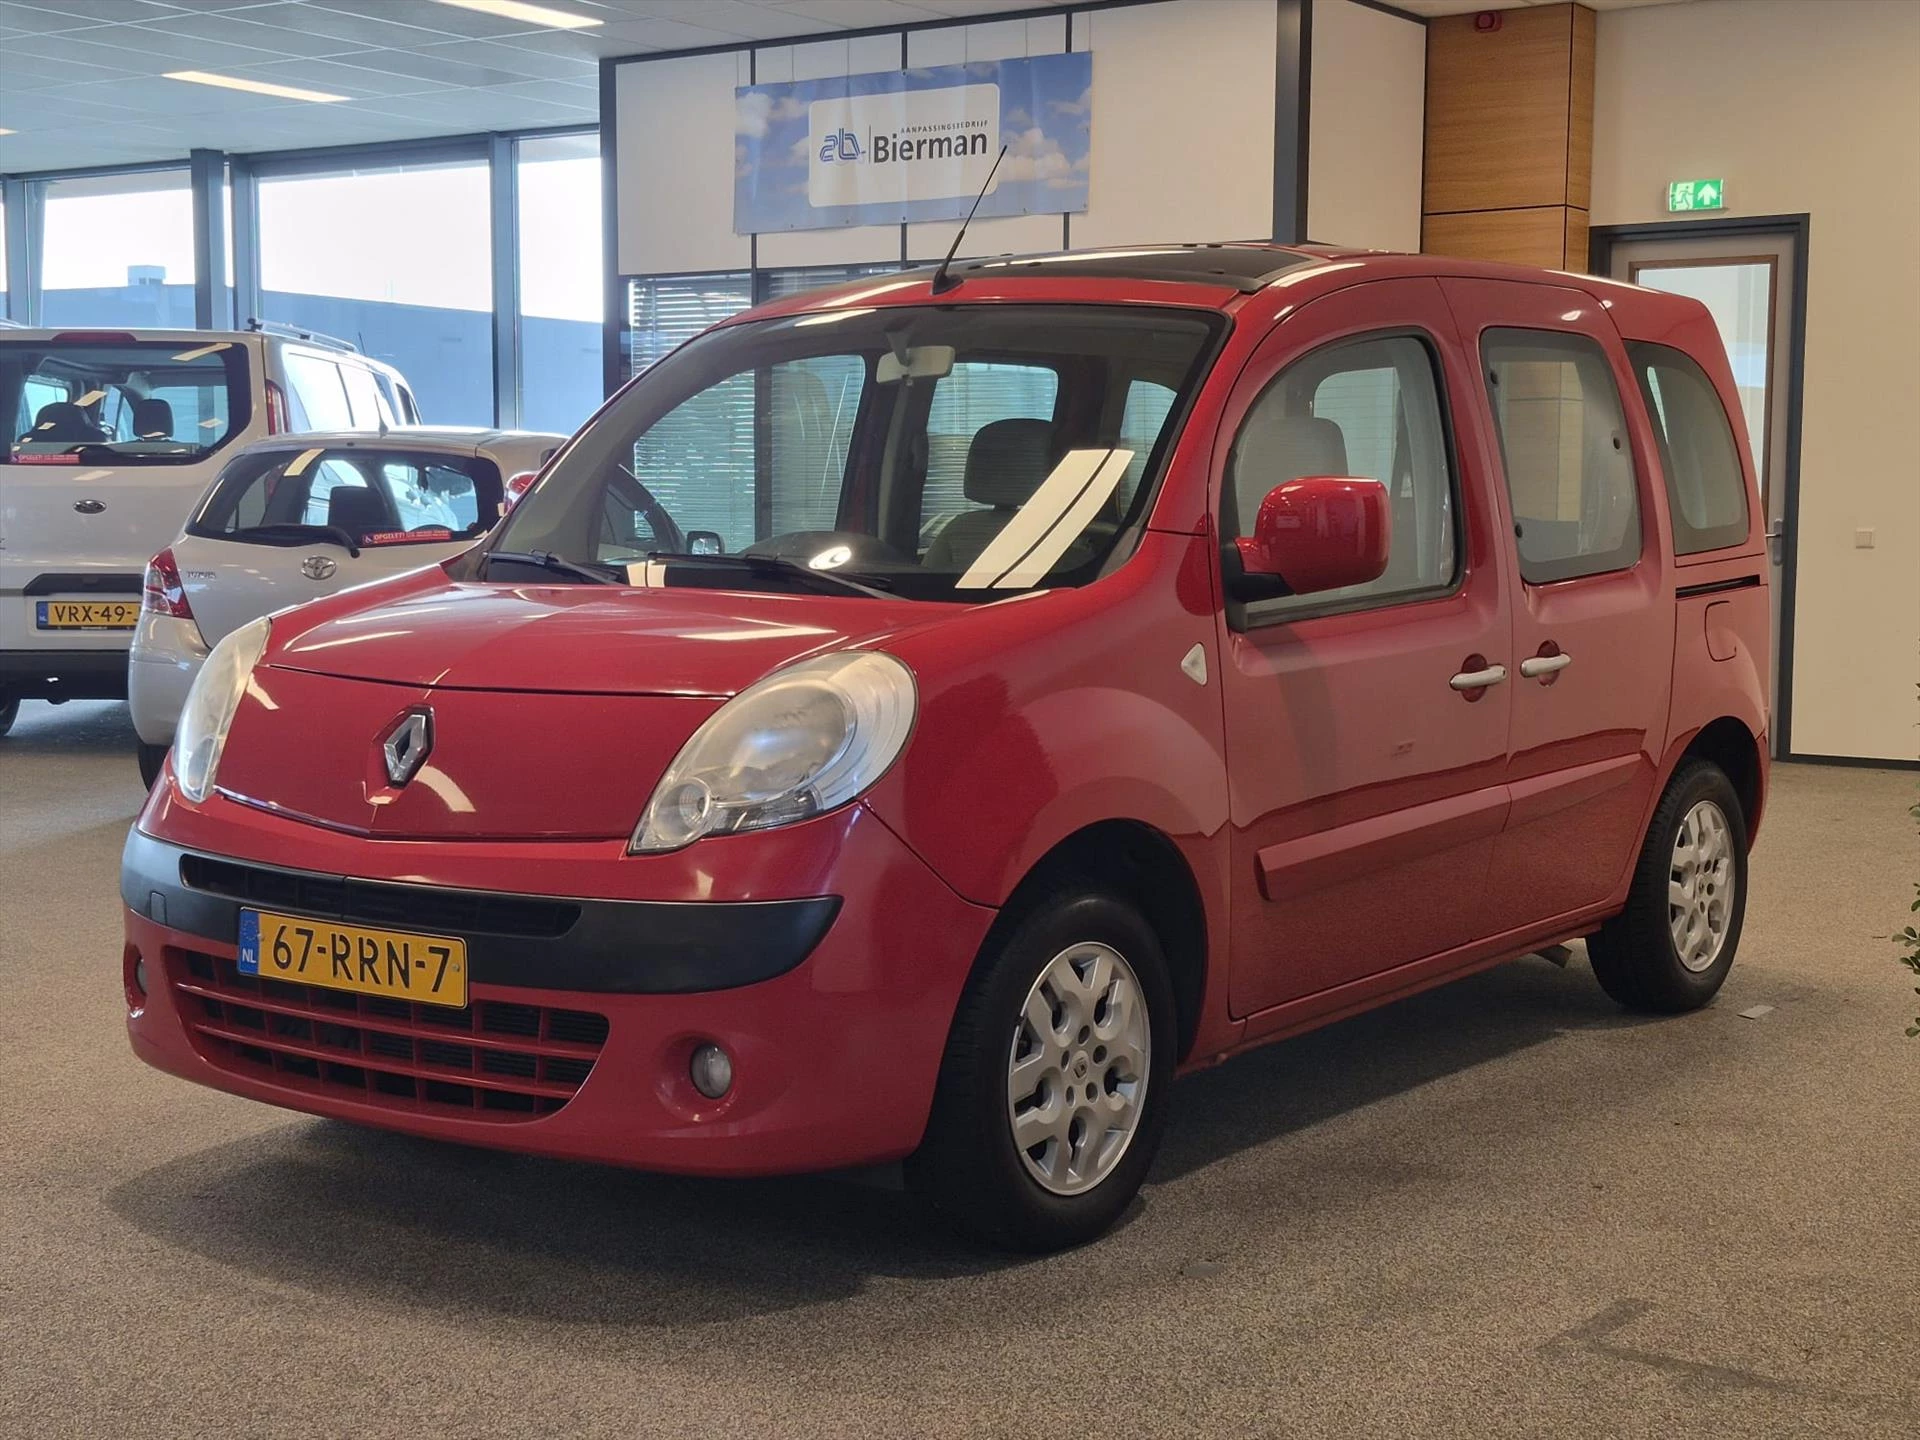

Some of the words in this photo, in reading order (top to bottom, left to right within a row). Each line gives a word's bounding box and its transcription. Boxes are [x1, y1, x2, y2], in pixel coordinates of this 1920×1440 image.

[873, 132, 988, 163] Bierman
[241, 947, 257, 964] NL
[273, 925, 450, 993] 67-RRN-7
